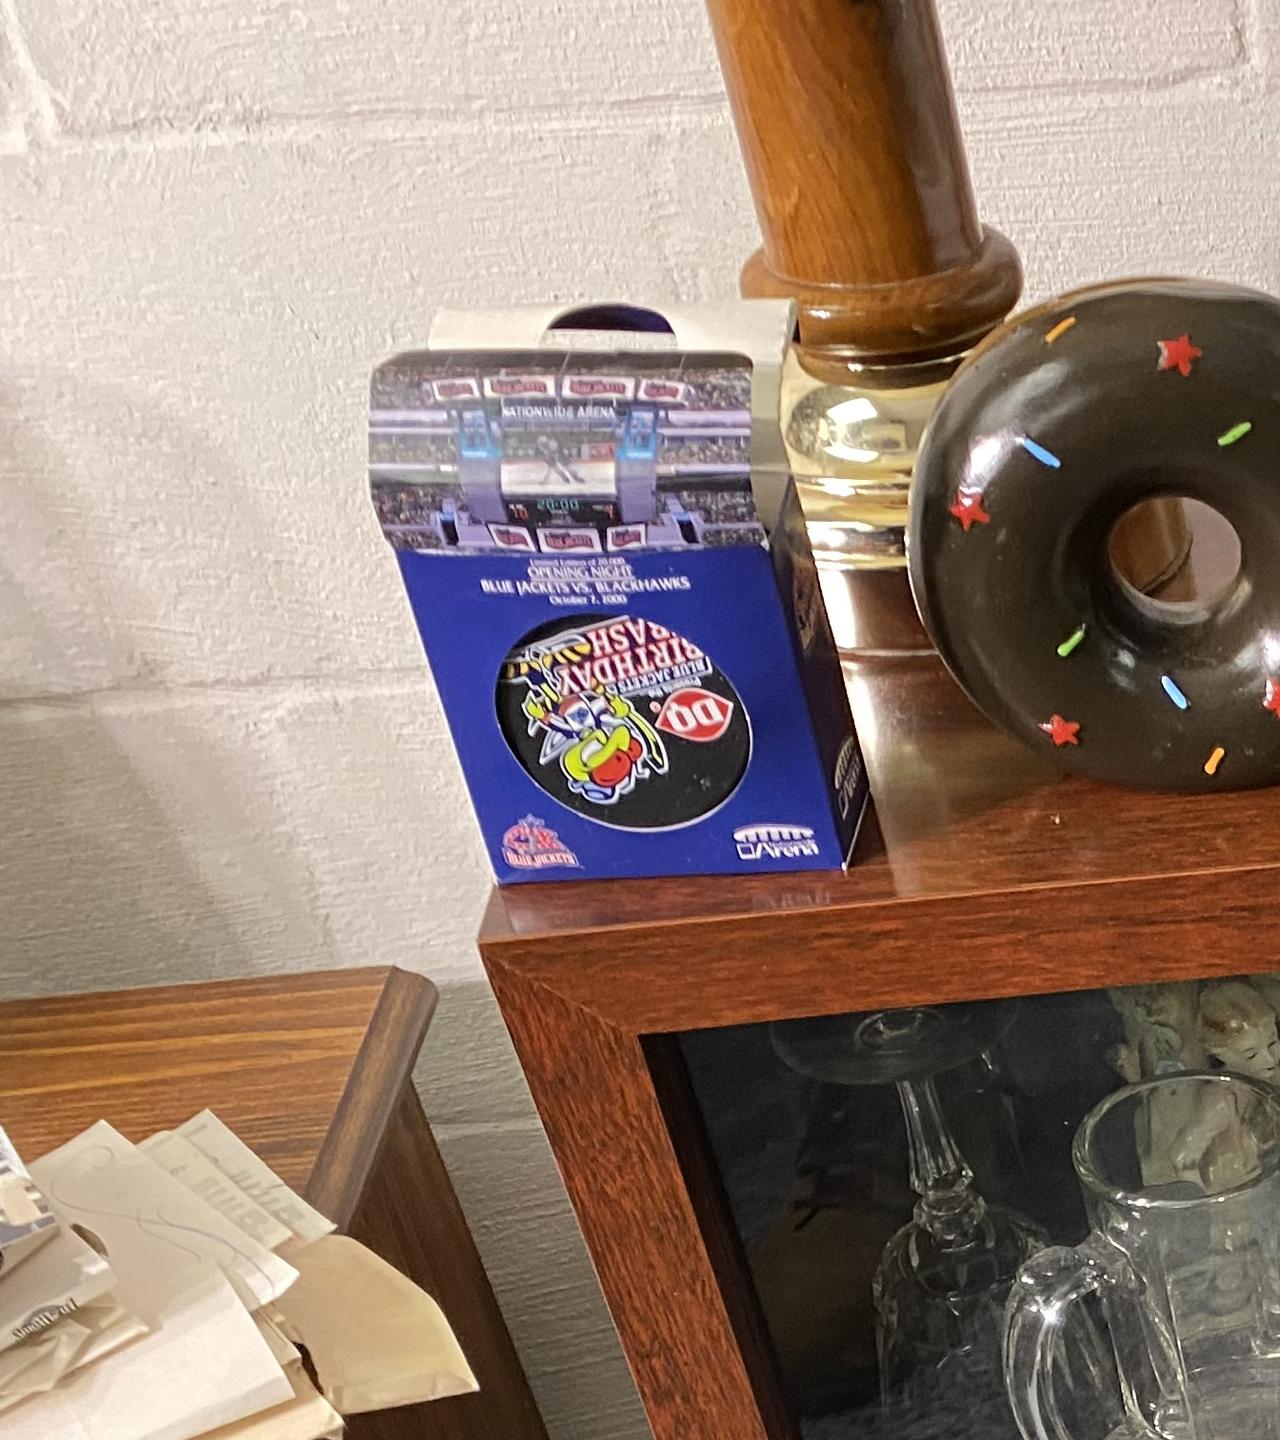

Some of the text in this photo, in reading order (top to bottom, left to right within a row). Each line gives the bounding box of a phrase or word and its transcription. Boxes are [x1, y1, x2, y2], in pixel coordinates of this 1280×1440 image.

[576, 406, 616, 418] ARENA
[527, 564, 634, 580] OPENING NIGHT
[481, 575, 692, 597] BLUE JACKETS VS. BLACKHAWKS
[549, 594, 589, 606] October
[602, 593, 628, 605] 2000
[618, 658, 706, 692] BLUE JACKETS
[667, 698, 725, 733] DQ
[755, 842, 820, 859] Arena
